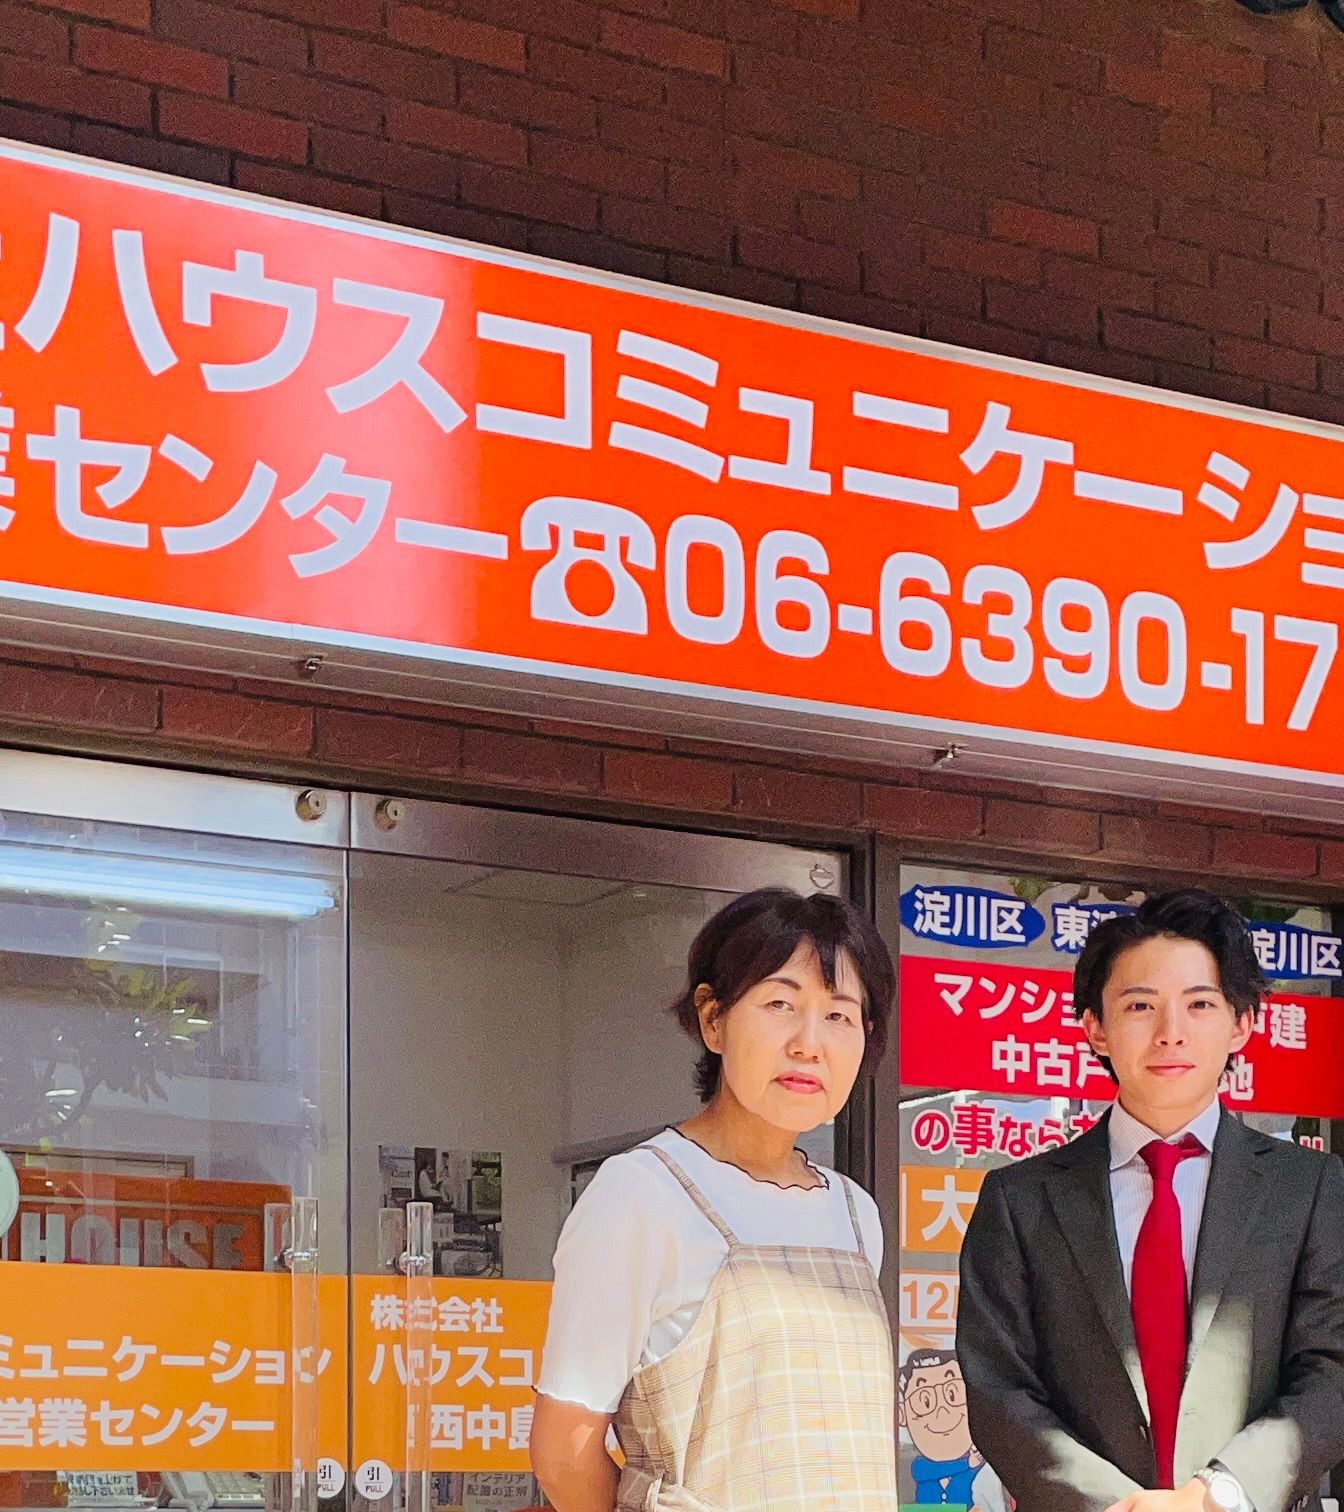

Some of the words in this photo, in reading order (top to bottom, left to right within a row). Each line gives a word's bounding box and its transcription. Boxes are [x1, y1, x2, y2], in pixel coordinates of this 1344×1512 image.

[912, 888, 1027, 944] 淀川区
[1254, 1003, 1307, 1051] 建
